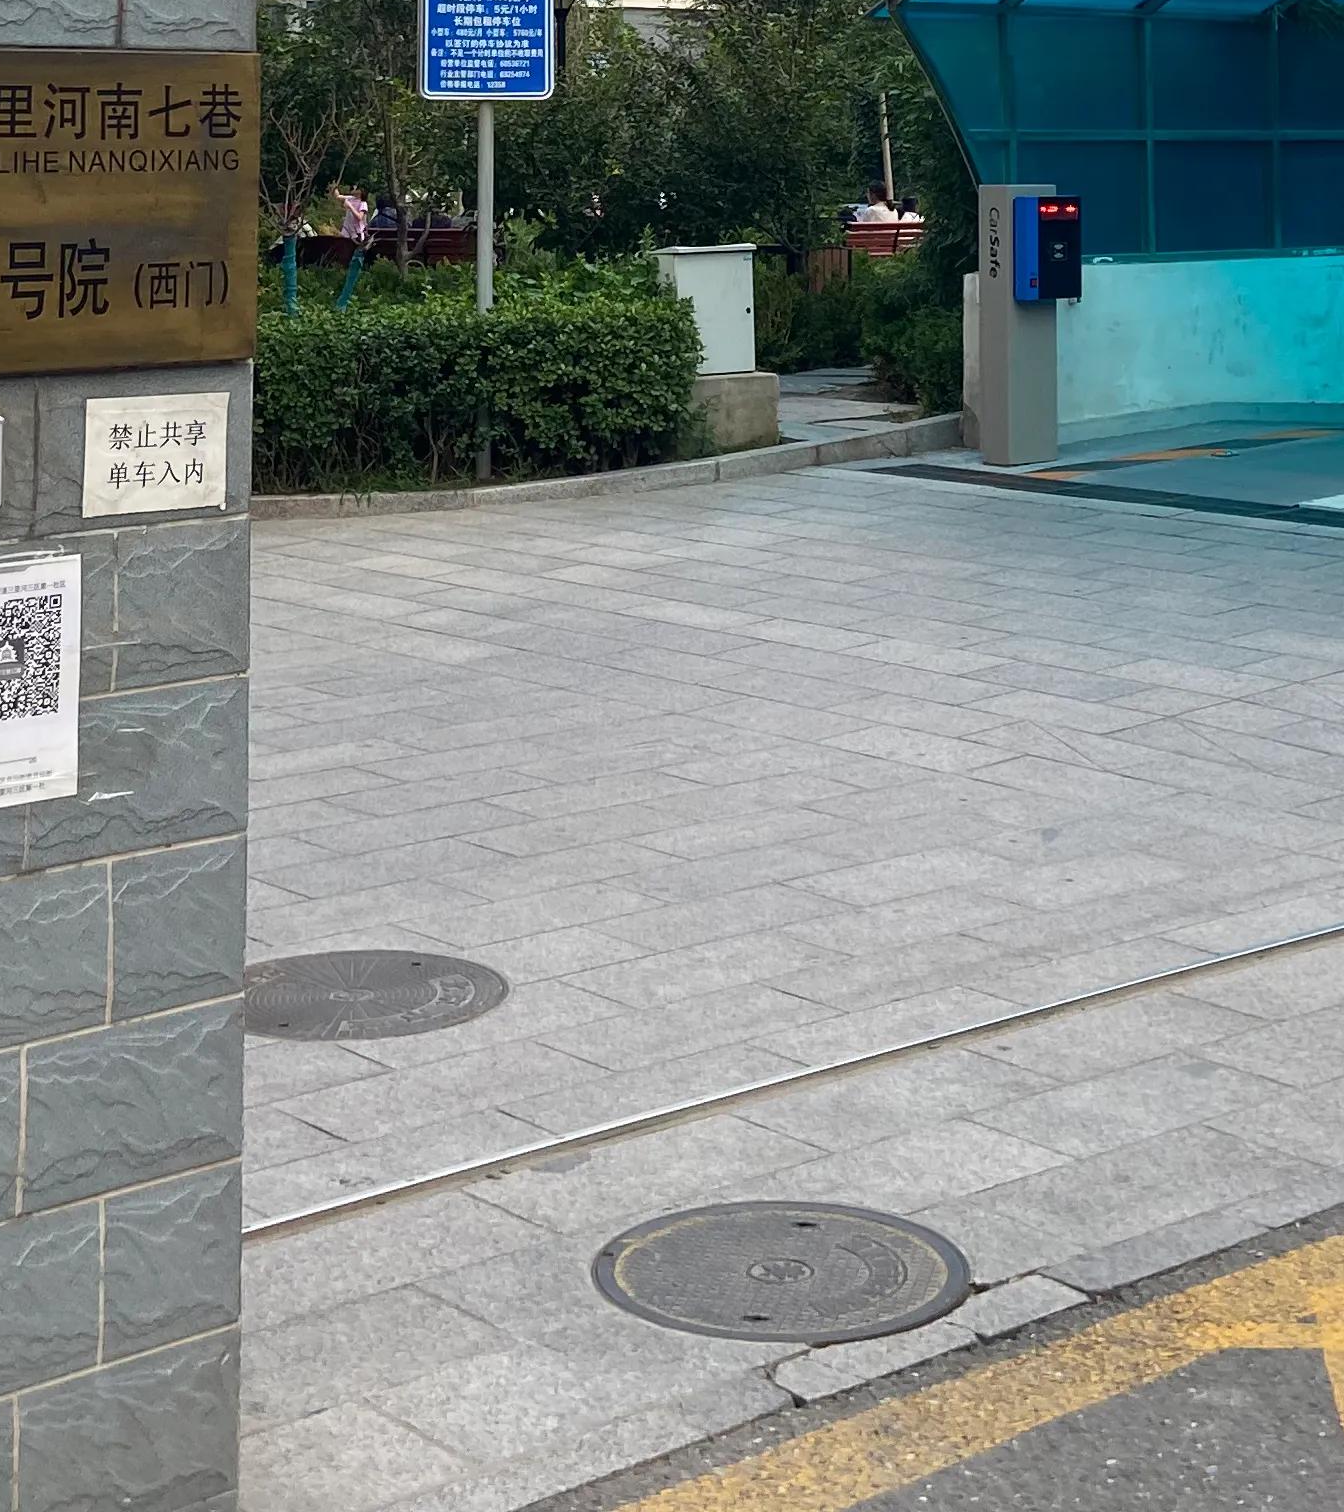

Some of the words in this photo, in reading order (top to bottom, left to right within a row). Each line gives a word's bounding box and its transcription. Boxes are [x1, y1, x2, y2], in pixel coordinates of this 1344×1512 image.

[69, 148, 239, 173] NANQIXIANG
[988, 207, 1001, 279] CarSafe
[109, 420, 206, 450] 禁止共享
[107, 458, 203, 489] 单车入内
